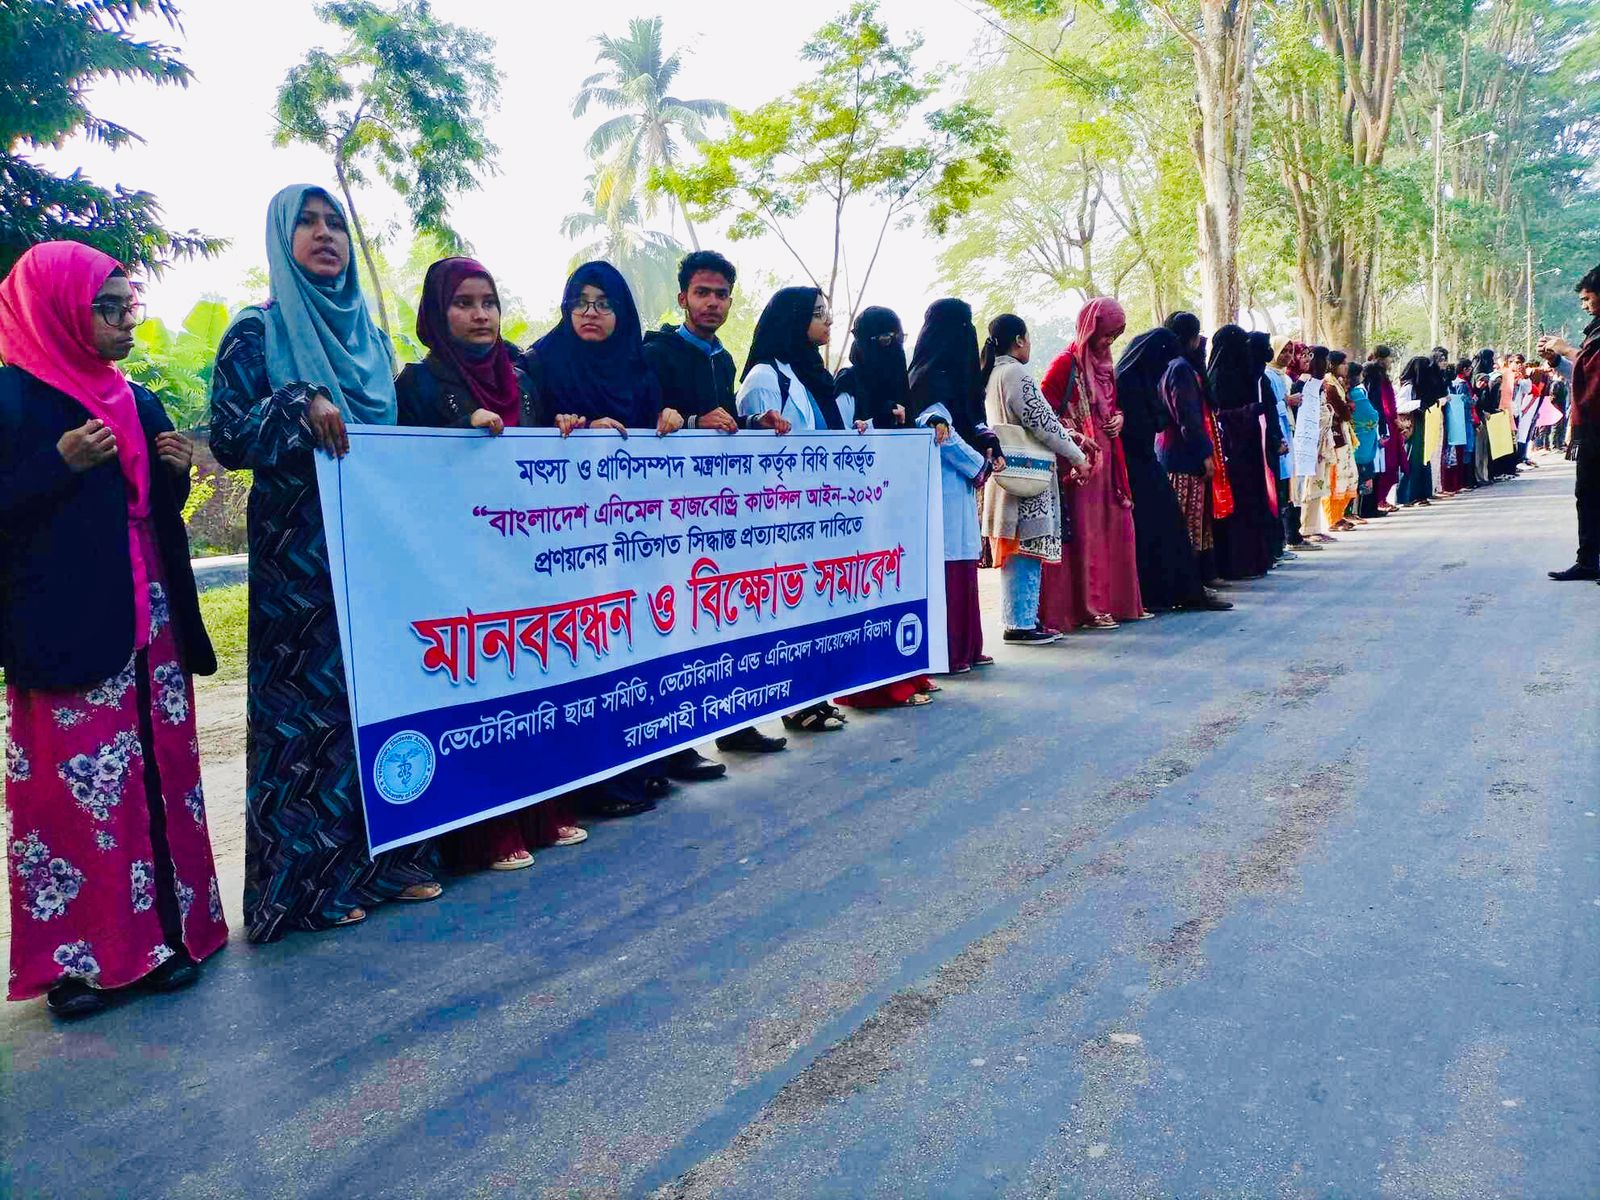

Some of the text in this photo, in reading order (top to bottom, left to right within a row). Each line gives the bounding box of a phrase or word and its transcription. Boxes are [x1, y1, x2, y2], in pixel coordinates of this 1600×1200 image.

[515, 445, 876, 485] মৎস্য ও প্রাণিসম্পদ মন্ত্রণালয় কর্তৃক বিধি বহির্ভূত
[473, 502, 590, 537] “বাংলাদেশ
[594, 494, 664, 526] এনিমেল
[744, 484, 802, 512] কাউন্সিল
[534, 512, 864, 577] প্রণয়নের নীতিগত সিদ্ধান্ত প্রত্যাহারের দাবিতে
[410, 542, 905, 685] মানববন্ধন ও বিক্ষোভ সমাবেশ
[439, 701, 558, 756] ভেটেরিনারি
[563, 697, 597, 726] ছাত্র
[601, 677, 655, 712] সমিতি,
[659, 652, 734, 697] ভেটেরিনারি
[738, 652, 761, 673] এন্ড
[765, 640, 811, 666] এনিমেল
[864, 619, 893, 642] বিভাগ
[623, 679, 793, 748] রাজশাহী বিশ্ববিদ্যালয়
